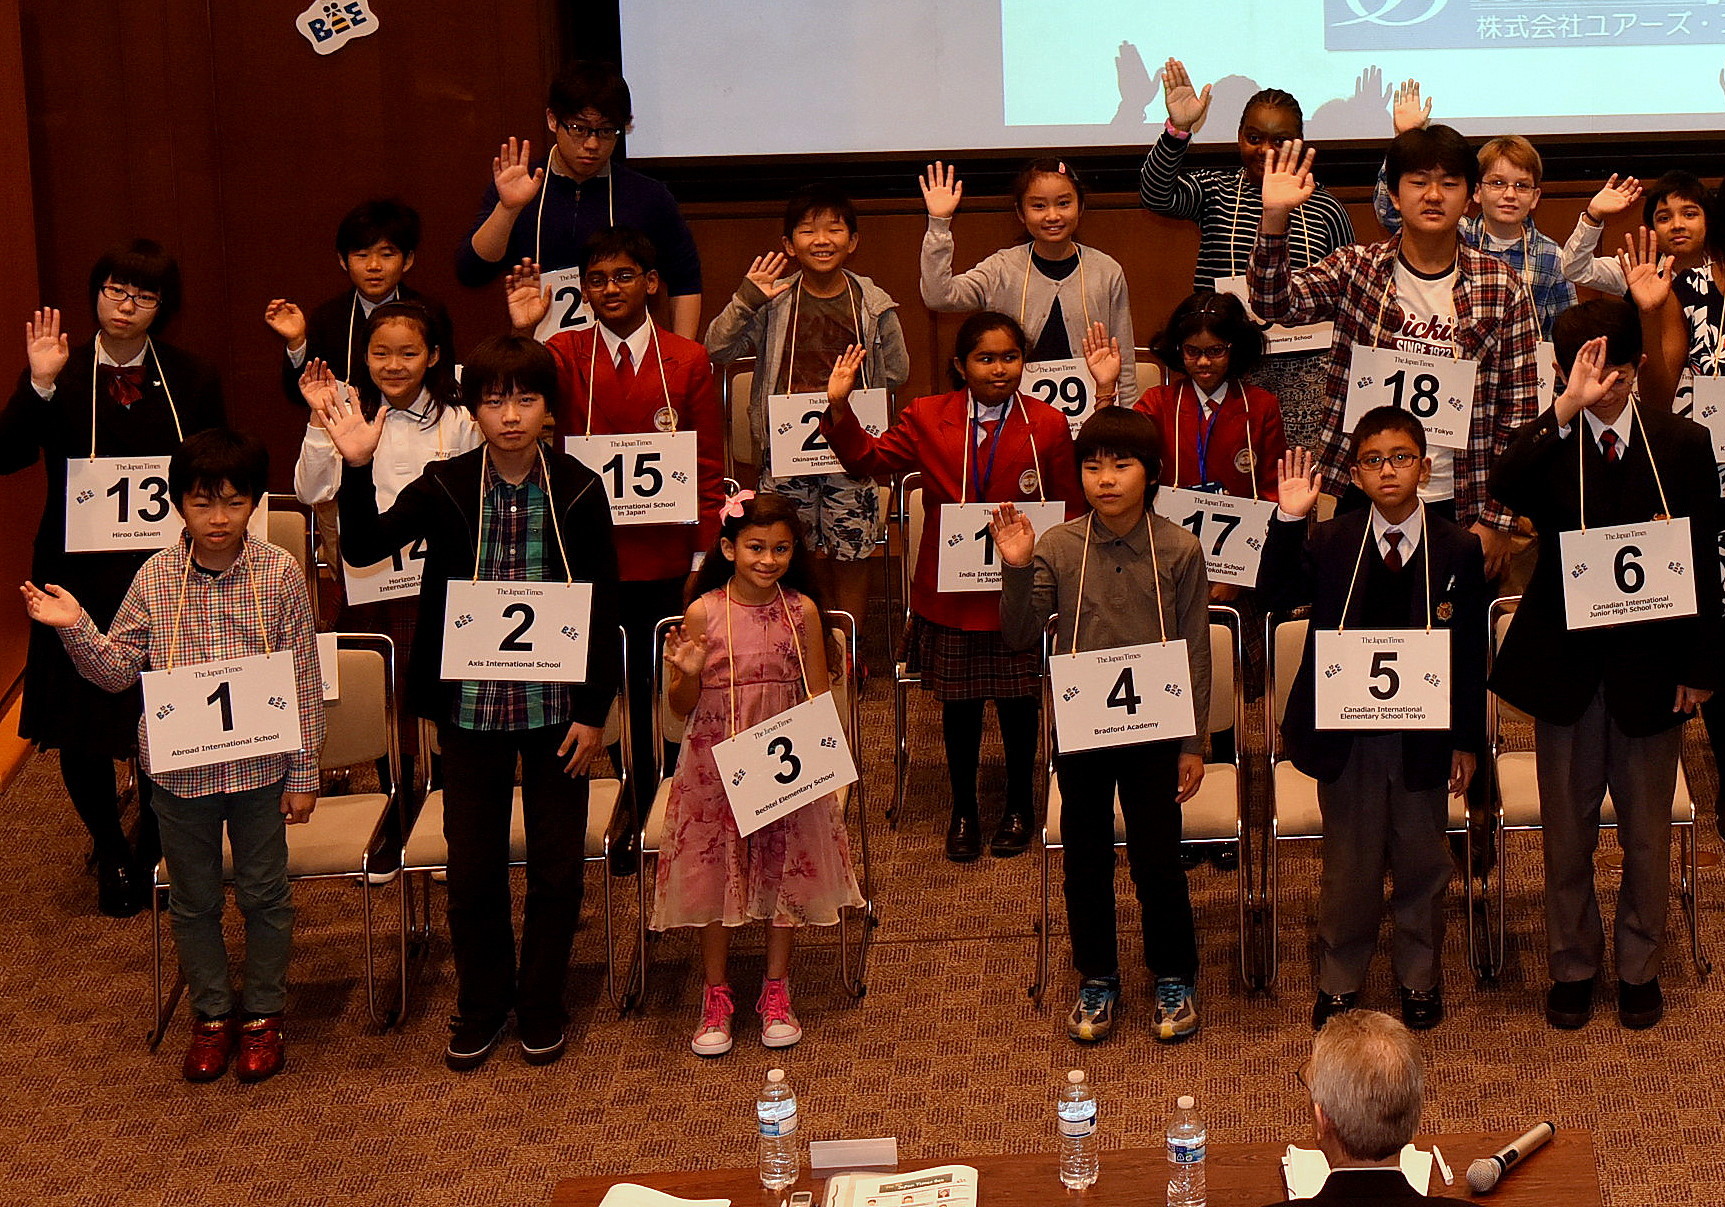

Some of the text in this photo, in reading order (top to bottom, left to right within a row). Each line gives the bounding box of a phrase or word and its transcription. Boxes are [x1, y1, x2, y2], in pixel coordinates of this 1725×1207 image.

[1294, 334, 1313, 342] School
[1032, 376, 1087, 417] 29
[1383, 369, 1440, 418] 18
[800, 410, 829, 451] 2
[1433, 427, 1454, 436] Tokyo
[602, 452, 664, 499] 15
[106, 476, 170, 523] 13
[653, 501, 676, 509] School
[133, 530, 161, 538] Gakuen
[1182, 510, 1242, 557] 17
[389, 576, 416, 585] Horizon
[1224, 562, 1245, 572] School
[1613, 545, 1645, 594] 6
[379, 581, 422, 593] Internation
[1592, 595, 1669, 611] Canadian International
[1589, 602, 1674, 618] Junior High School Tokyo
[498, 602, 536, 652] 2
[486, 660, 535, 668] International
[536, 661, 561, 669] School
[1368, 652, 1400, 700] 5
[206, 681, 234, 732] 1
[1106, 667, 1142, 715] 4
[1094, 721, 1159, 735] Bradford Academy
[1340, 713, 1379, 721] Elementary
[171, 733, 280, 757] Abroad International School
[767, 736, 801, 785] 3
[754, 771, 835, 816] Bechtel Elementary School
